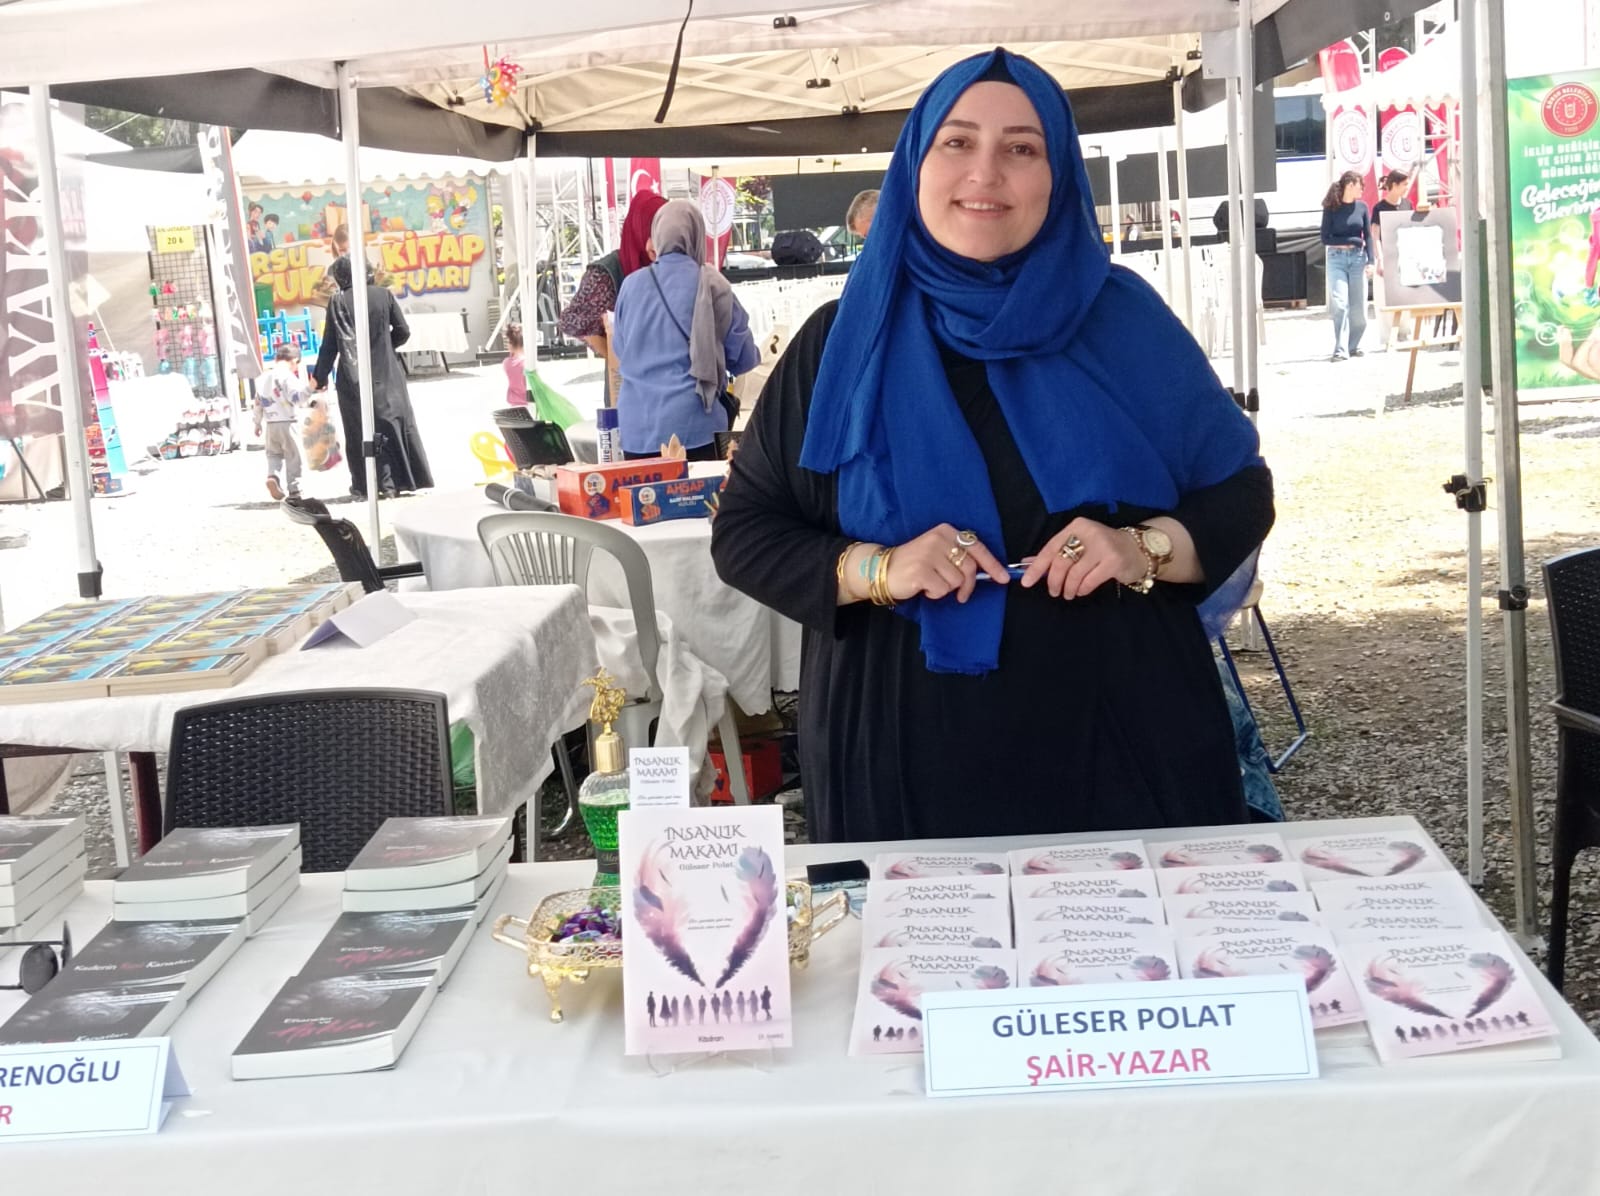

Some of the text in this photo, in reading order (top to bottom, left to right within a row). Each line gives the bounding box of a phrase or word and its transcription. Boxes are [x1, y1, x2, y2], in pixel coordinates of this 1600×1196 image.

[167, 237, 177, 245] 20
[382, 231, 485, 272] KİTAP
[669, 843, 738, 860] MAKAMI
[991, 1003, 1236, 1038] GÜLESER POLAT
[1026, 1047, 1211, 1086] ŞAİR-YAZAR
